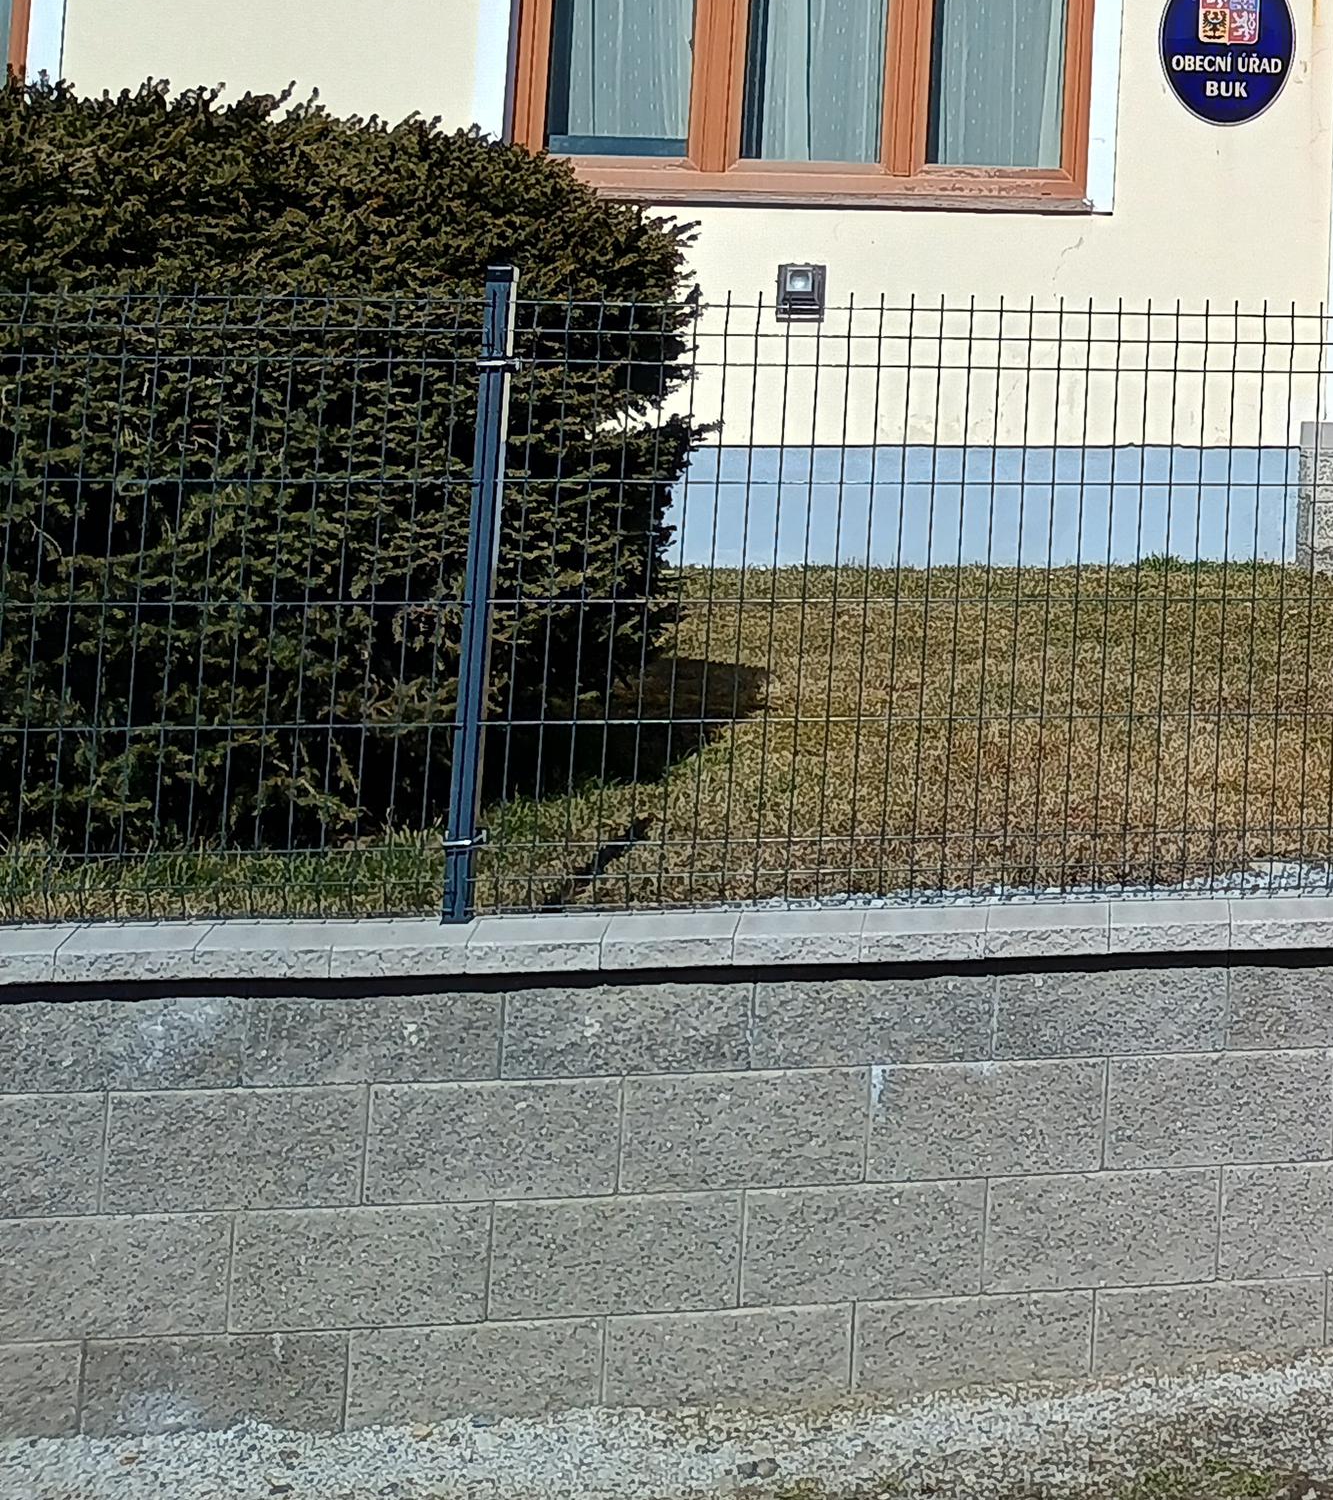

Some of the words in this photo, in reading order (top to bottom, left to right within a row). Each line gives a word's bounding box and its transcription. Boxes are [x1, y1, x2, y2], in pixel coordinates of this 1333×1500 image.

[1171, 52, 1232, 73] OBECNÍ
[1237, 53, 1282, 74] ÚŘAD
[1205, 81, 1248, 98] BUK
